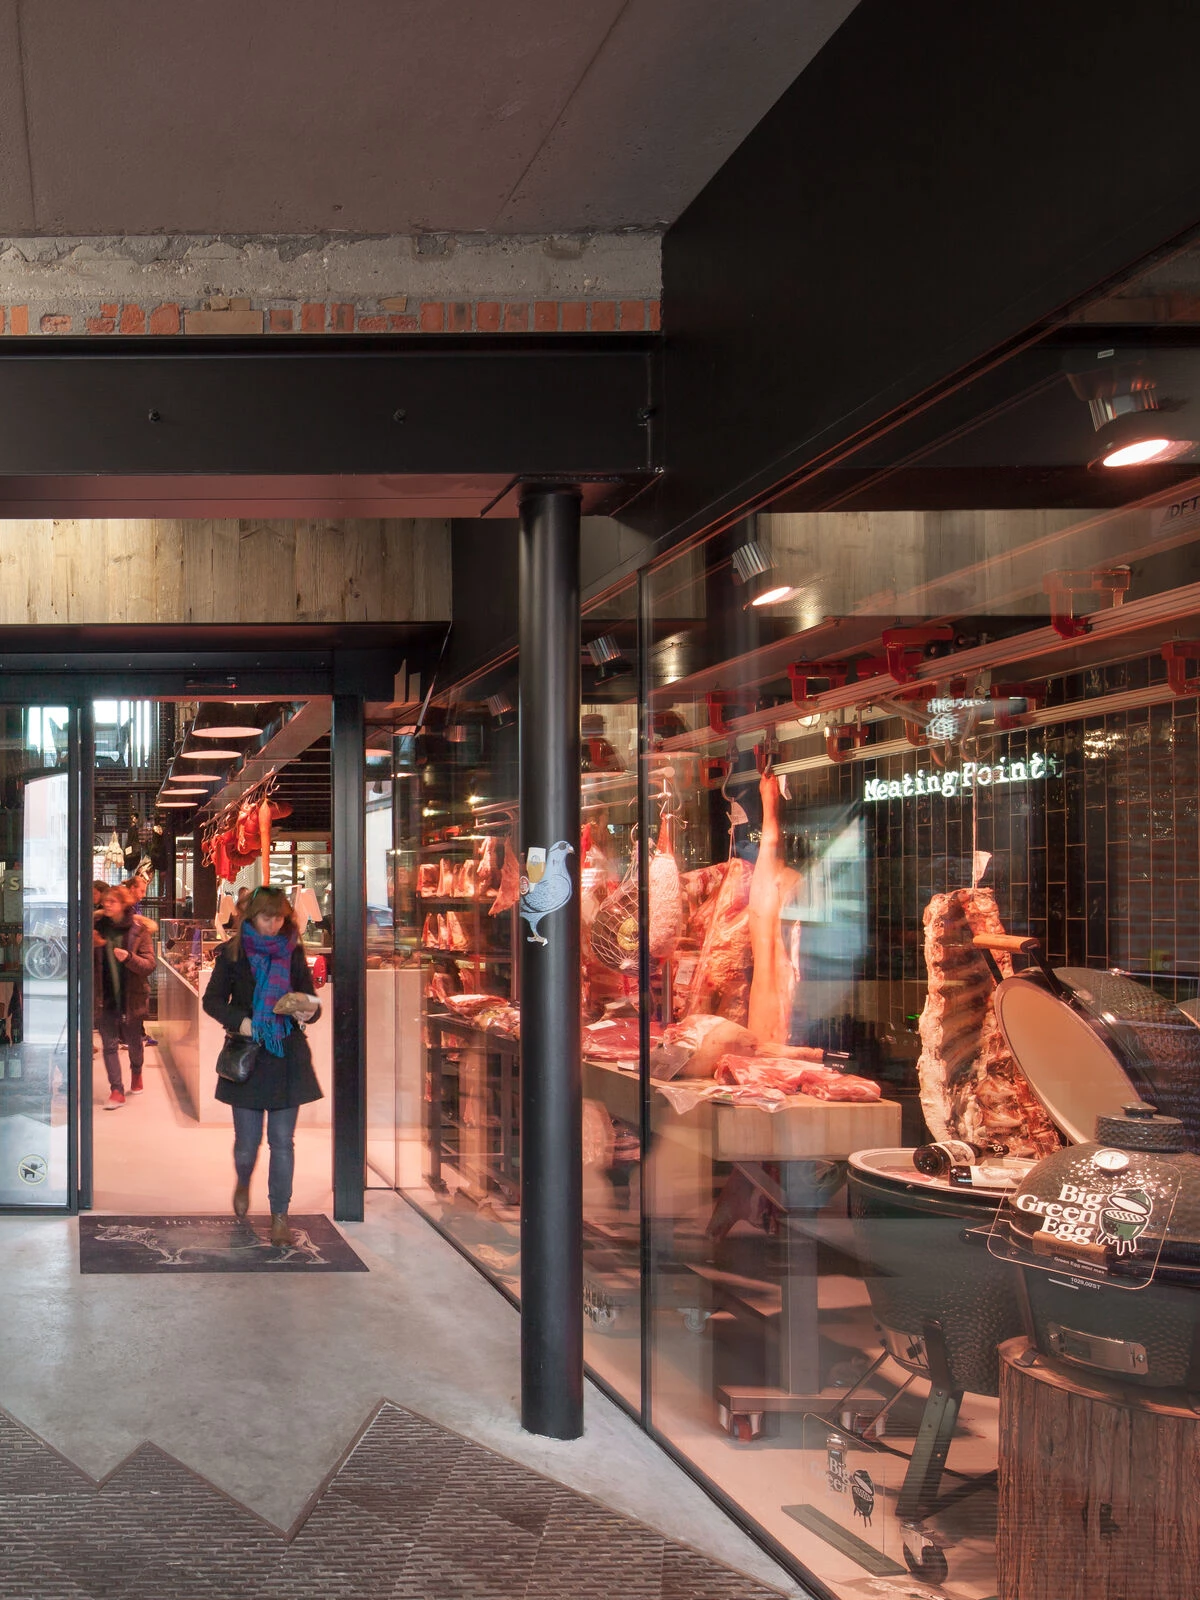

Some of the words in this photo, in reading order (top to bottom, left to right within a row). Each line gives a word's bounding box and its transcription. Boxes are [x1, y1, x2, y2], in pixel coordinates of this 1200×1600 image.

[864, 769, 960, 802] Meating
[962, 752, 1046, 788] Point
[1016, 1194, 1098, 1224] Green
[1058, 1184, 1106, 1211] Big
[1040, 1215, 1094, 1245] Egg
